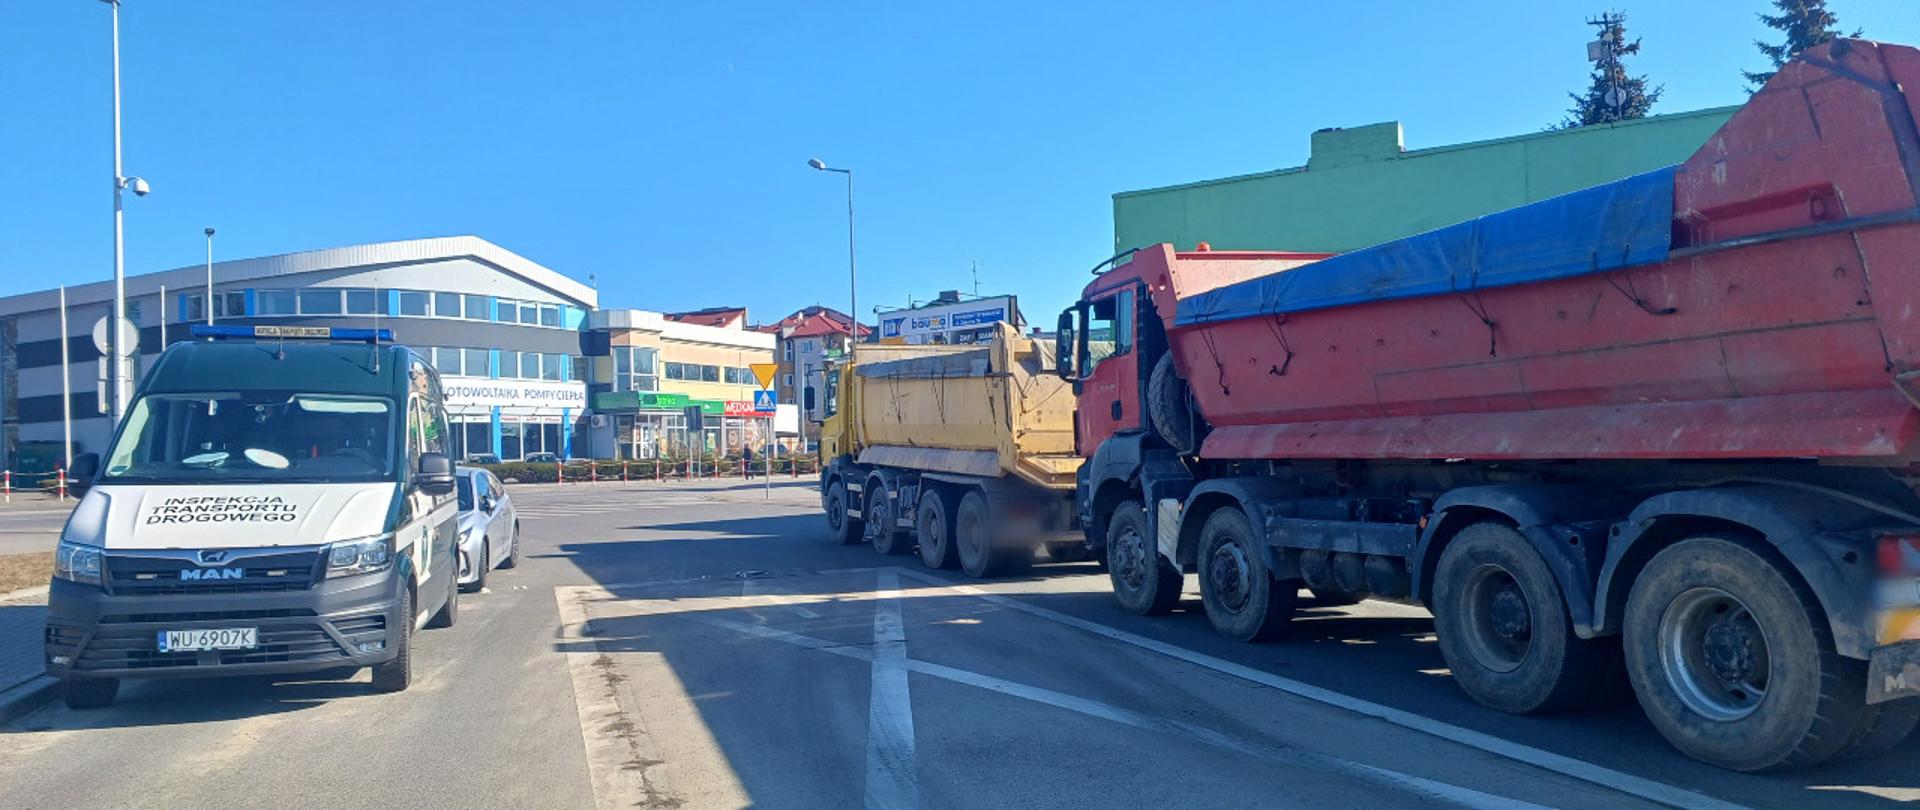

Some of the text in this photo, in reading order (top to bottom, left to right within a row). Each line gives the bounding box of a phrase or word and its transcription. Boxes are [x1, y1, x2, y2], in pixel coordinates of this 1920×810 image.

[524, 389, 556, 400] POMPY
[556, 390, 584, 401] CIEPŁA
[164, 496, 283, 505] INSPEKCJA
[152, 504, 297, 514] TRANSPORTU
[146, 513, 296, 525] DROGOWEGO
[180, 567, 243, 581] MAN
